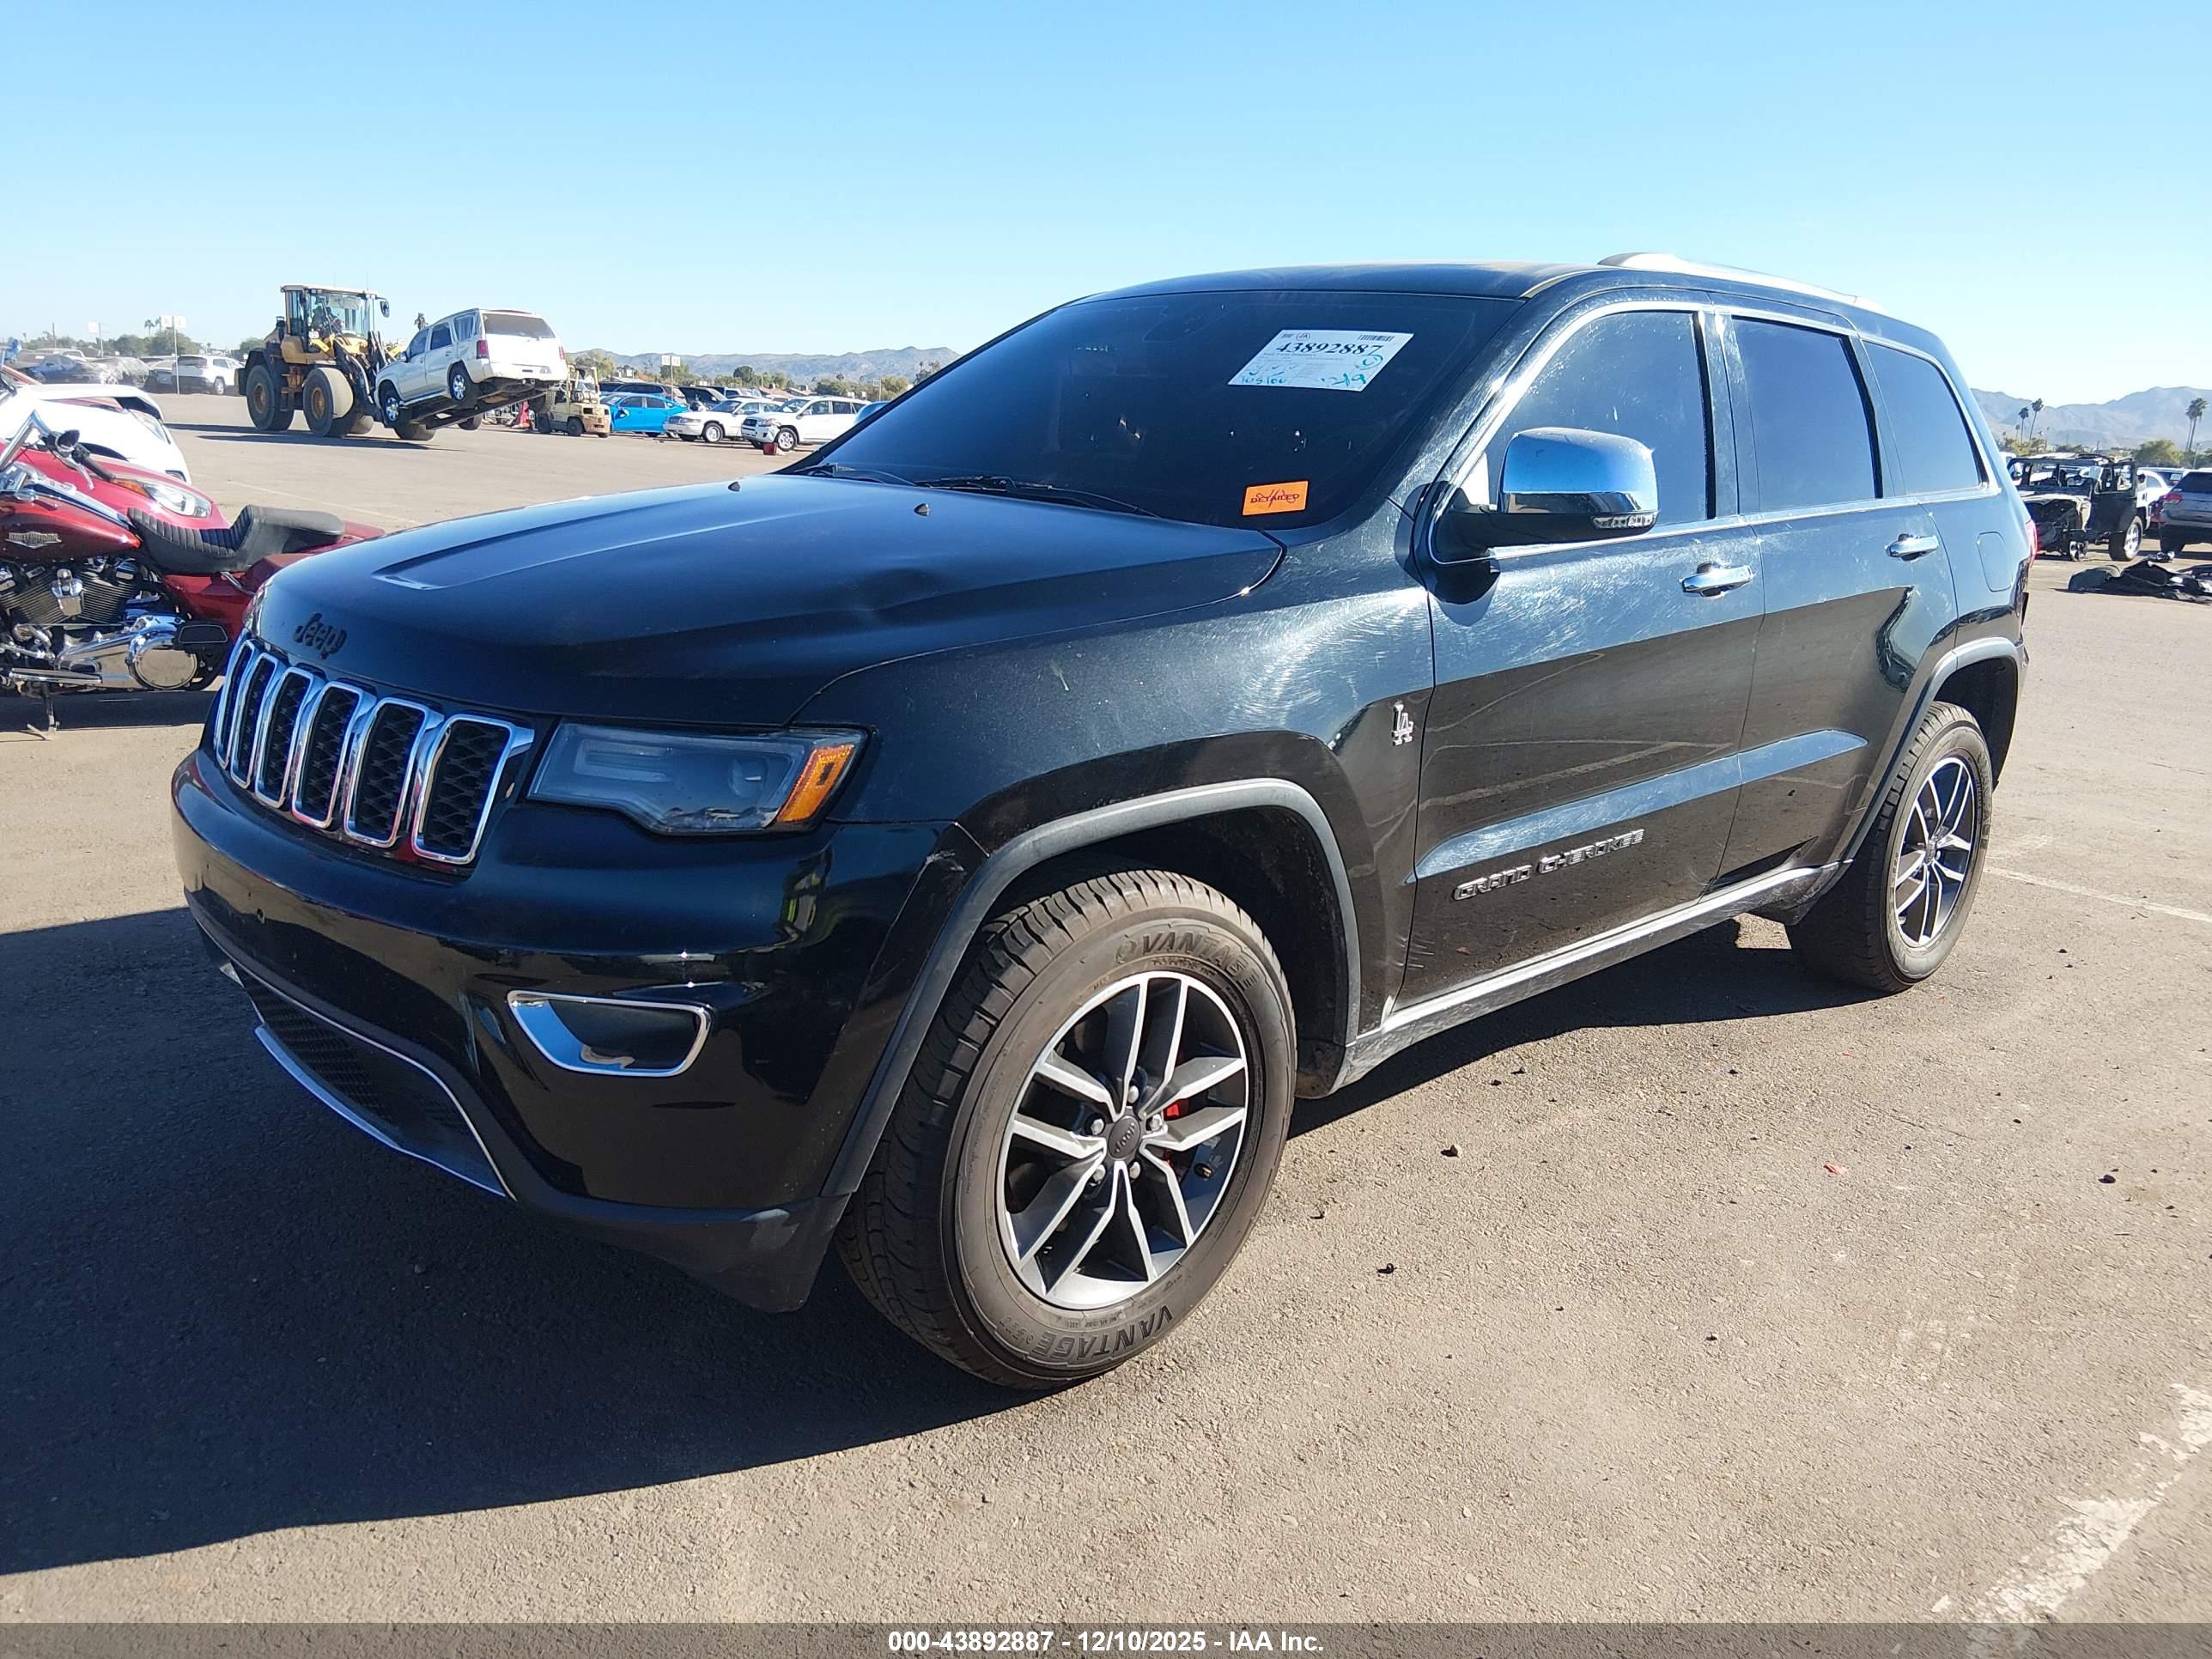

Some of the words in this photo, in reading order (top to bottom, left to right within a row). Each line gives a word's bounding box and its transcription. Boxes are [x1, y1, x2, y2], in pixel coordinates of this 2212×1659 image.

[1276, 343, 1383, 356] 43892887
[294, 612, 348, 659] Jeep
[1537, 829, 1645, 874] CHEROKEE
[1143, 932, 1259, 990] VANTAGE
[1032, 1304, 1174, 1360] VANTAGE
